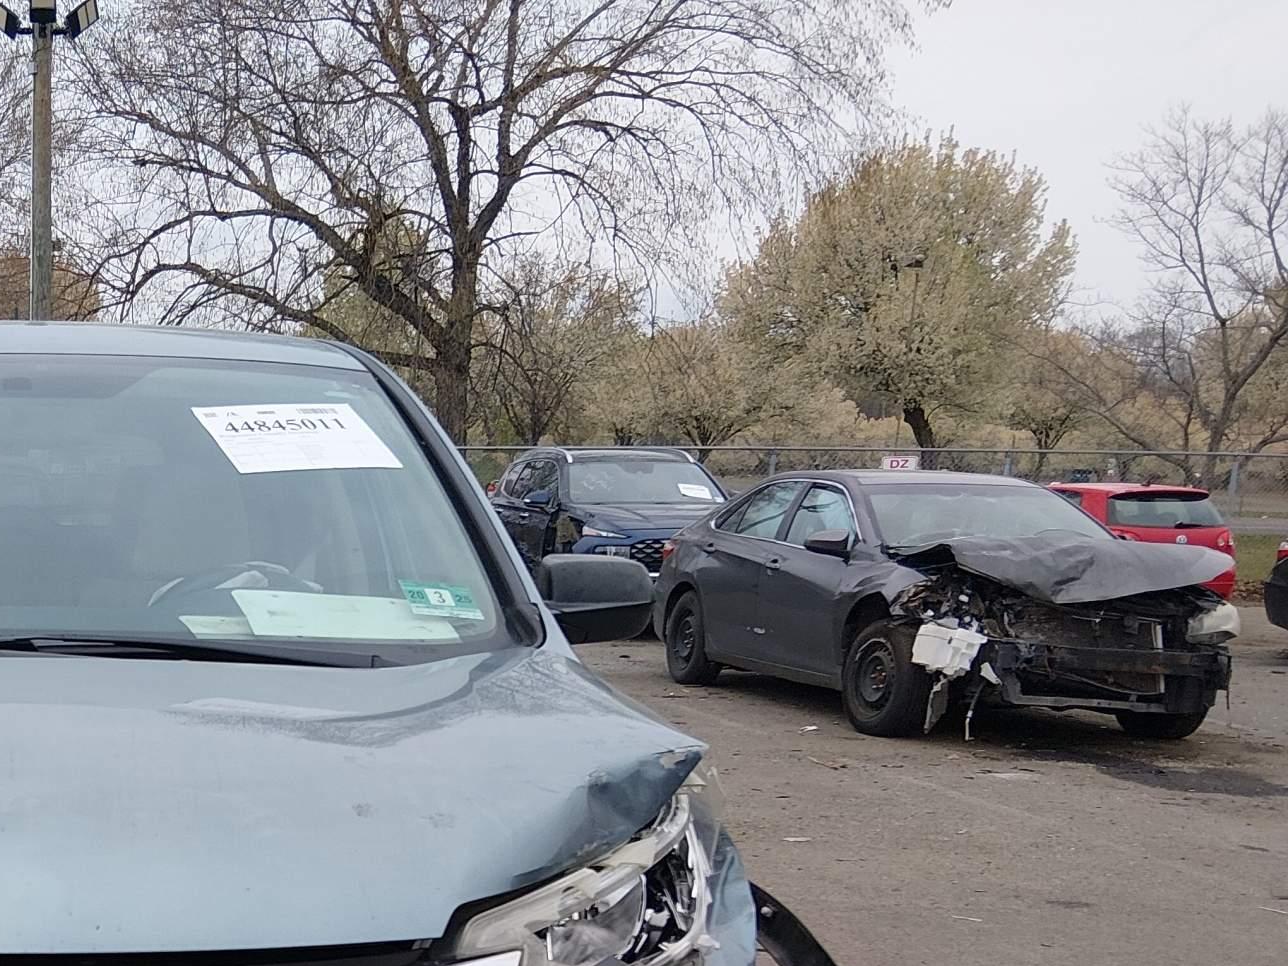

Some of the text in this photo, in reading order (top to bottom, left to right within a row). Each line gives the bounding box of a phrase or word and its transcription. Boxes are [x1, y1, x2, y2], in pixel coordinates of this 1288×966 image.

[224, 418, 347, 433] 44845011
[890, 459, 909, 468] DZ
[433, 591, 446, 603] 3
